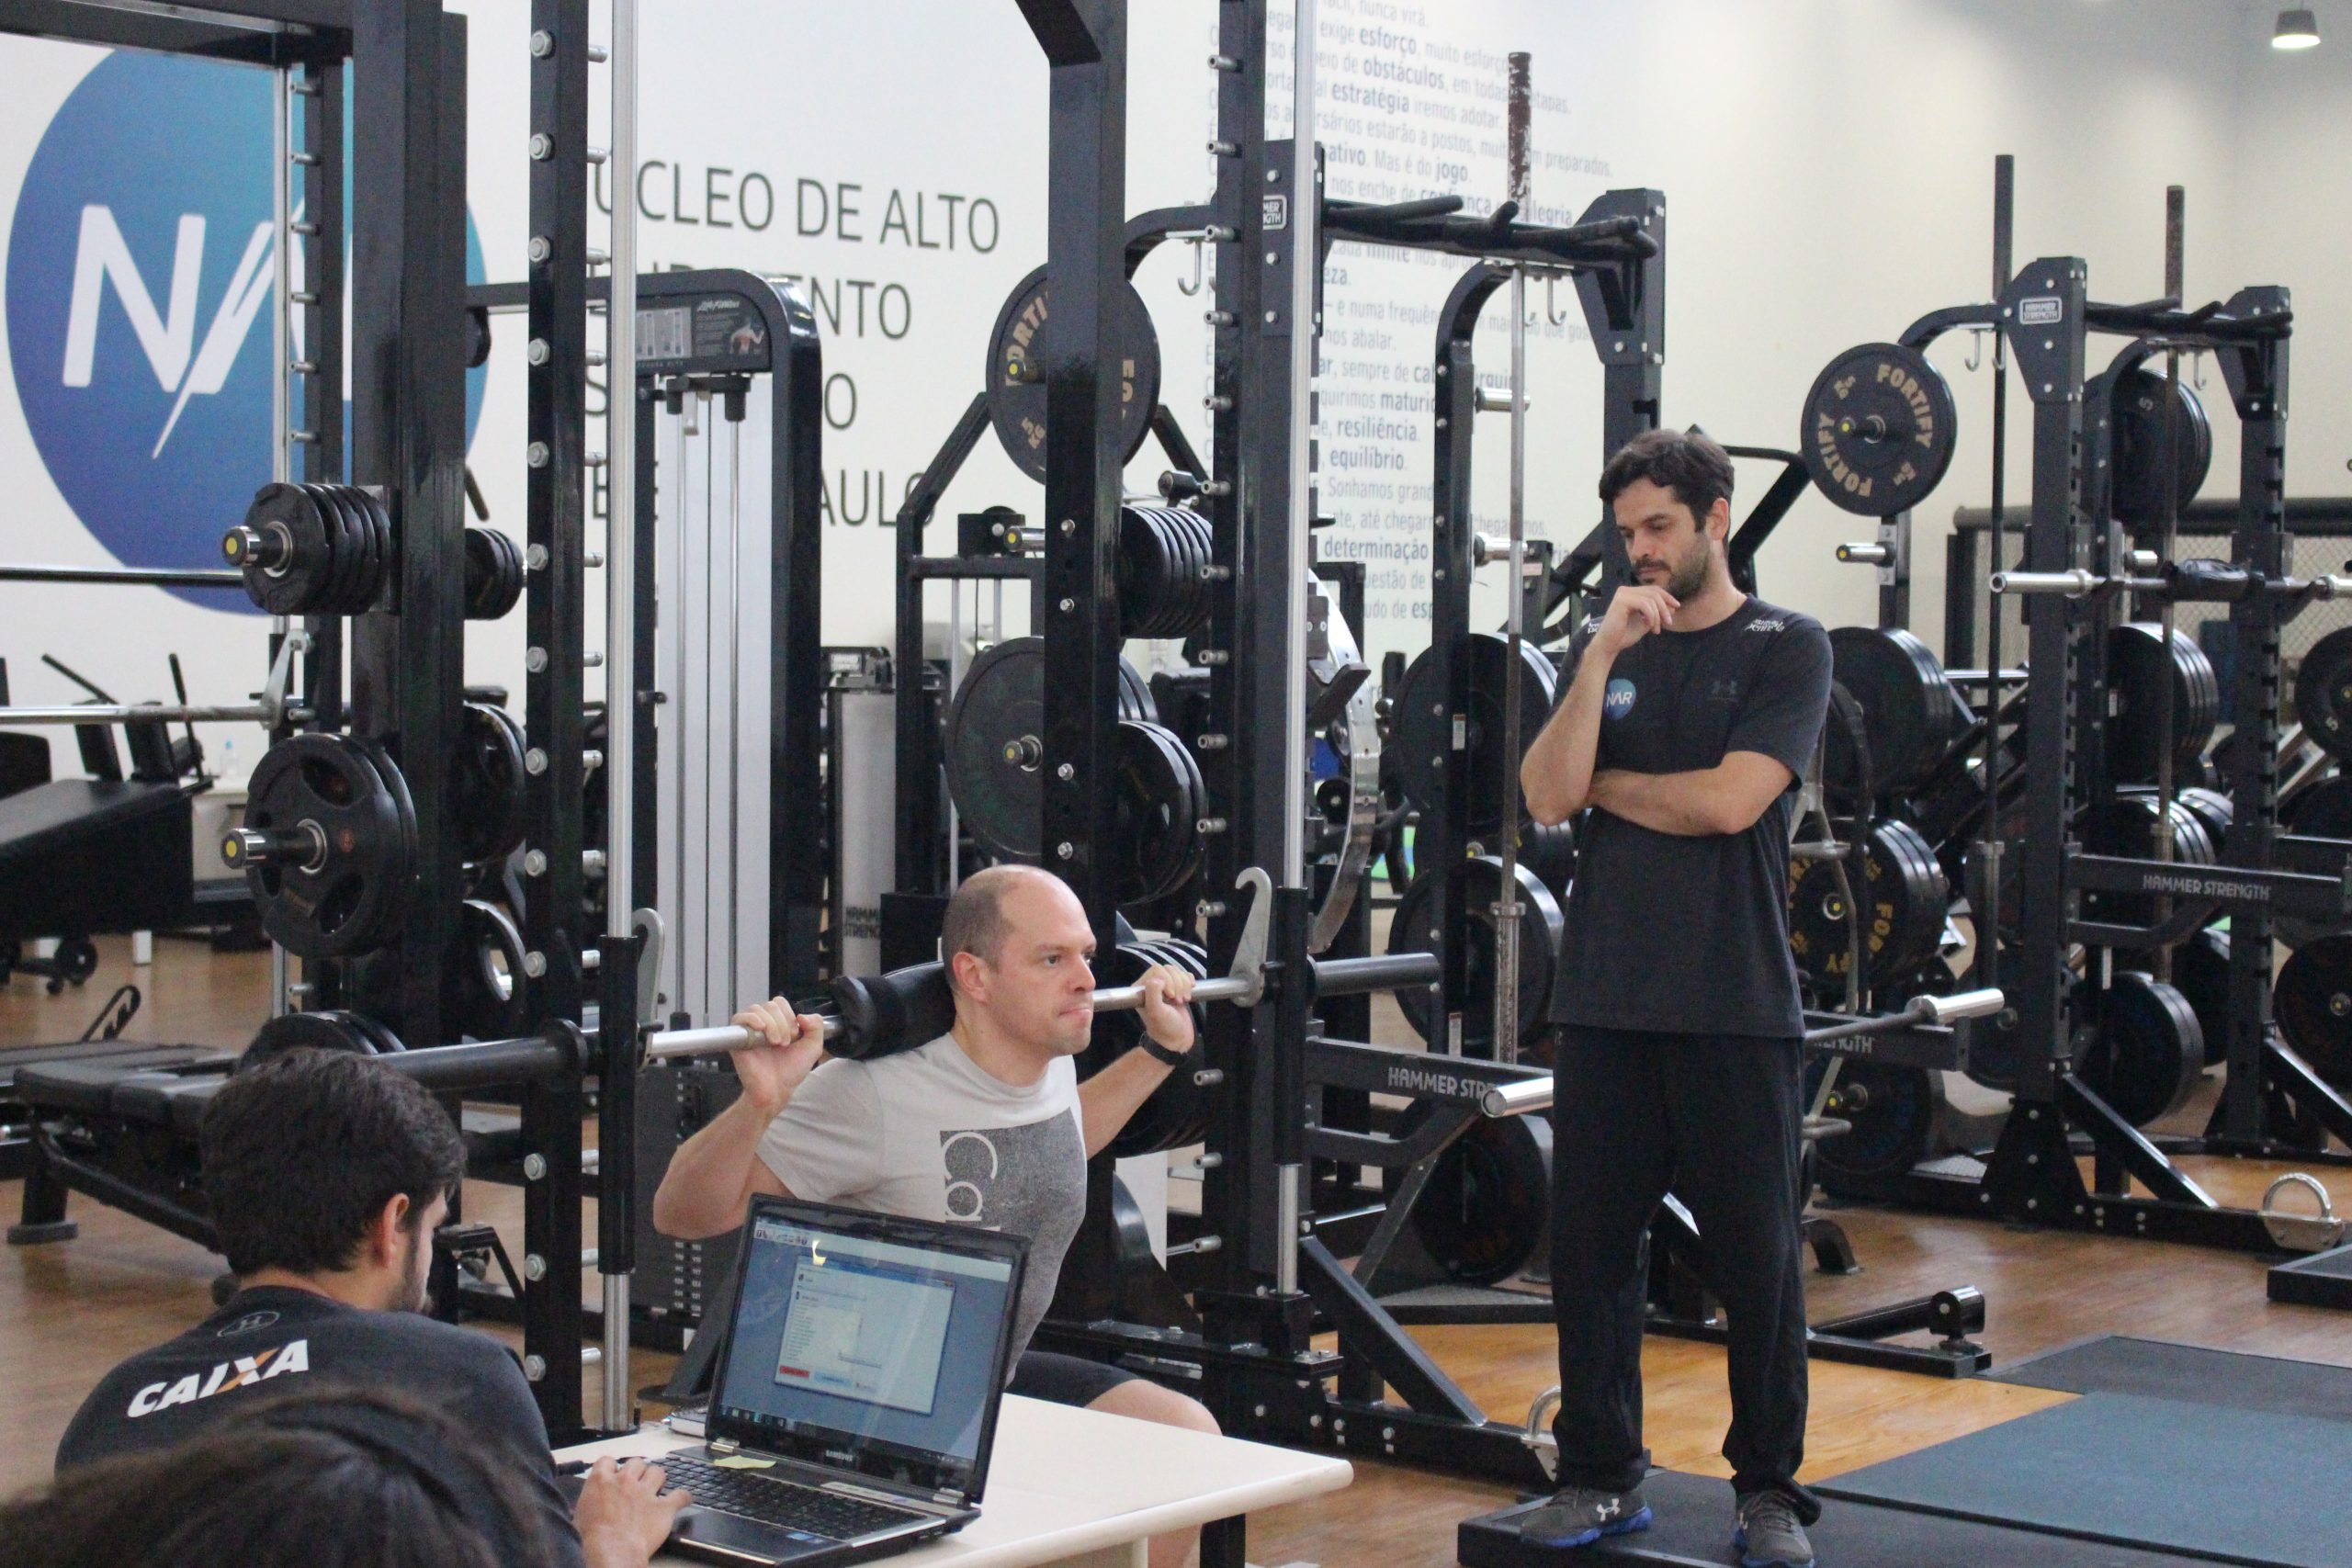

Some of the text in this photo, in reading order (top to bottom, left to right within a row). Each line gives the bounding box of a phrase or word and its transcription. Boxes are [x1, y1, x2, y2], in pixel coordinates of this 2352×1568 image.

[1320, 19, 1355, 44] exige
[1360, 26, 1420, 60] esforço,
[1426, 40, 1460, 62] muito
[1343, 51, 1359, 73] de
[1363, 58, 1449, 94] obstáculos,
[1453, 74, 1471, 94] em
[1332, 82, 1409, 114] estratégia
[1415, 99, 1456, 122] iremos
[1461, 107, 1505, 130] adotar.
[1367, 119, 1417, 143] estarão
[1420, 131, 1428, 146] a
[1432, 128, 1476, 158] postos,
[1545, 148, 1613, 178] preparados.
[1374, 149, 1400, 170] Mas
[1405, 156, 1413, 175] é
[1417, 158, 1431, 180] do
[1436, 156, 1472, 186] jogo.
[1332, 175, 1355, 195] nos
[1359, 178, 1397, 200] enche
[797, 178, 863, 242] DE
[879, 188, 1000, 254] ALTO
[1350, 299, 1385, 319] numa
[1325, 328, 1396, 352] nos abalar.
[1342, 362, 1391, 384] sempre
[1395, 361, 1410, 379] de
[1877, 364, 1933, 448] FORTIFY
[1337, 418, 1421, 442] resiliência.
[1329, 446, 1408, 470] equilíbrio.
[1817, 412, 1873, 498] FORTIFY
[1328, 476, 1395, 499] Sonhamos
[1360, 509, 1381, 529] até
[1323, 538, 1430, 566] determinação
[1411, 571, 1426, 591] de
[1392, 601, 1410, 619] de
[1607, 690, 1634, 708] NAR
[2143, 874, 2271, 901] HAMMER STRENGTH
[1388, 1066, 1458, 1096] HAMMER
[127, 1339, 309, 1418] CAIXA
